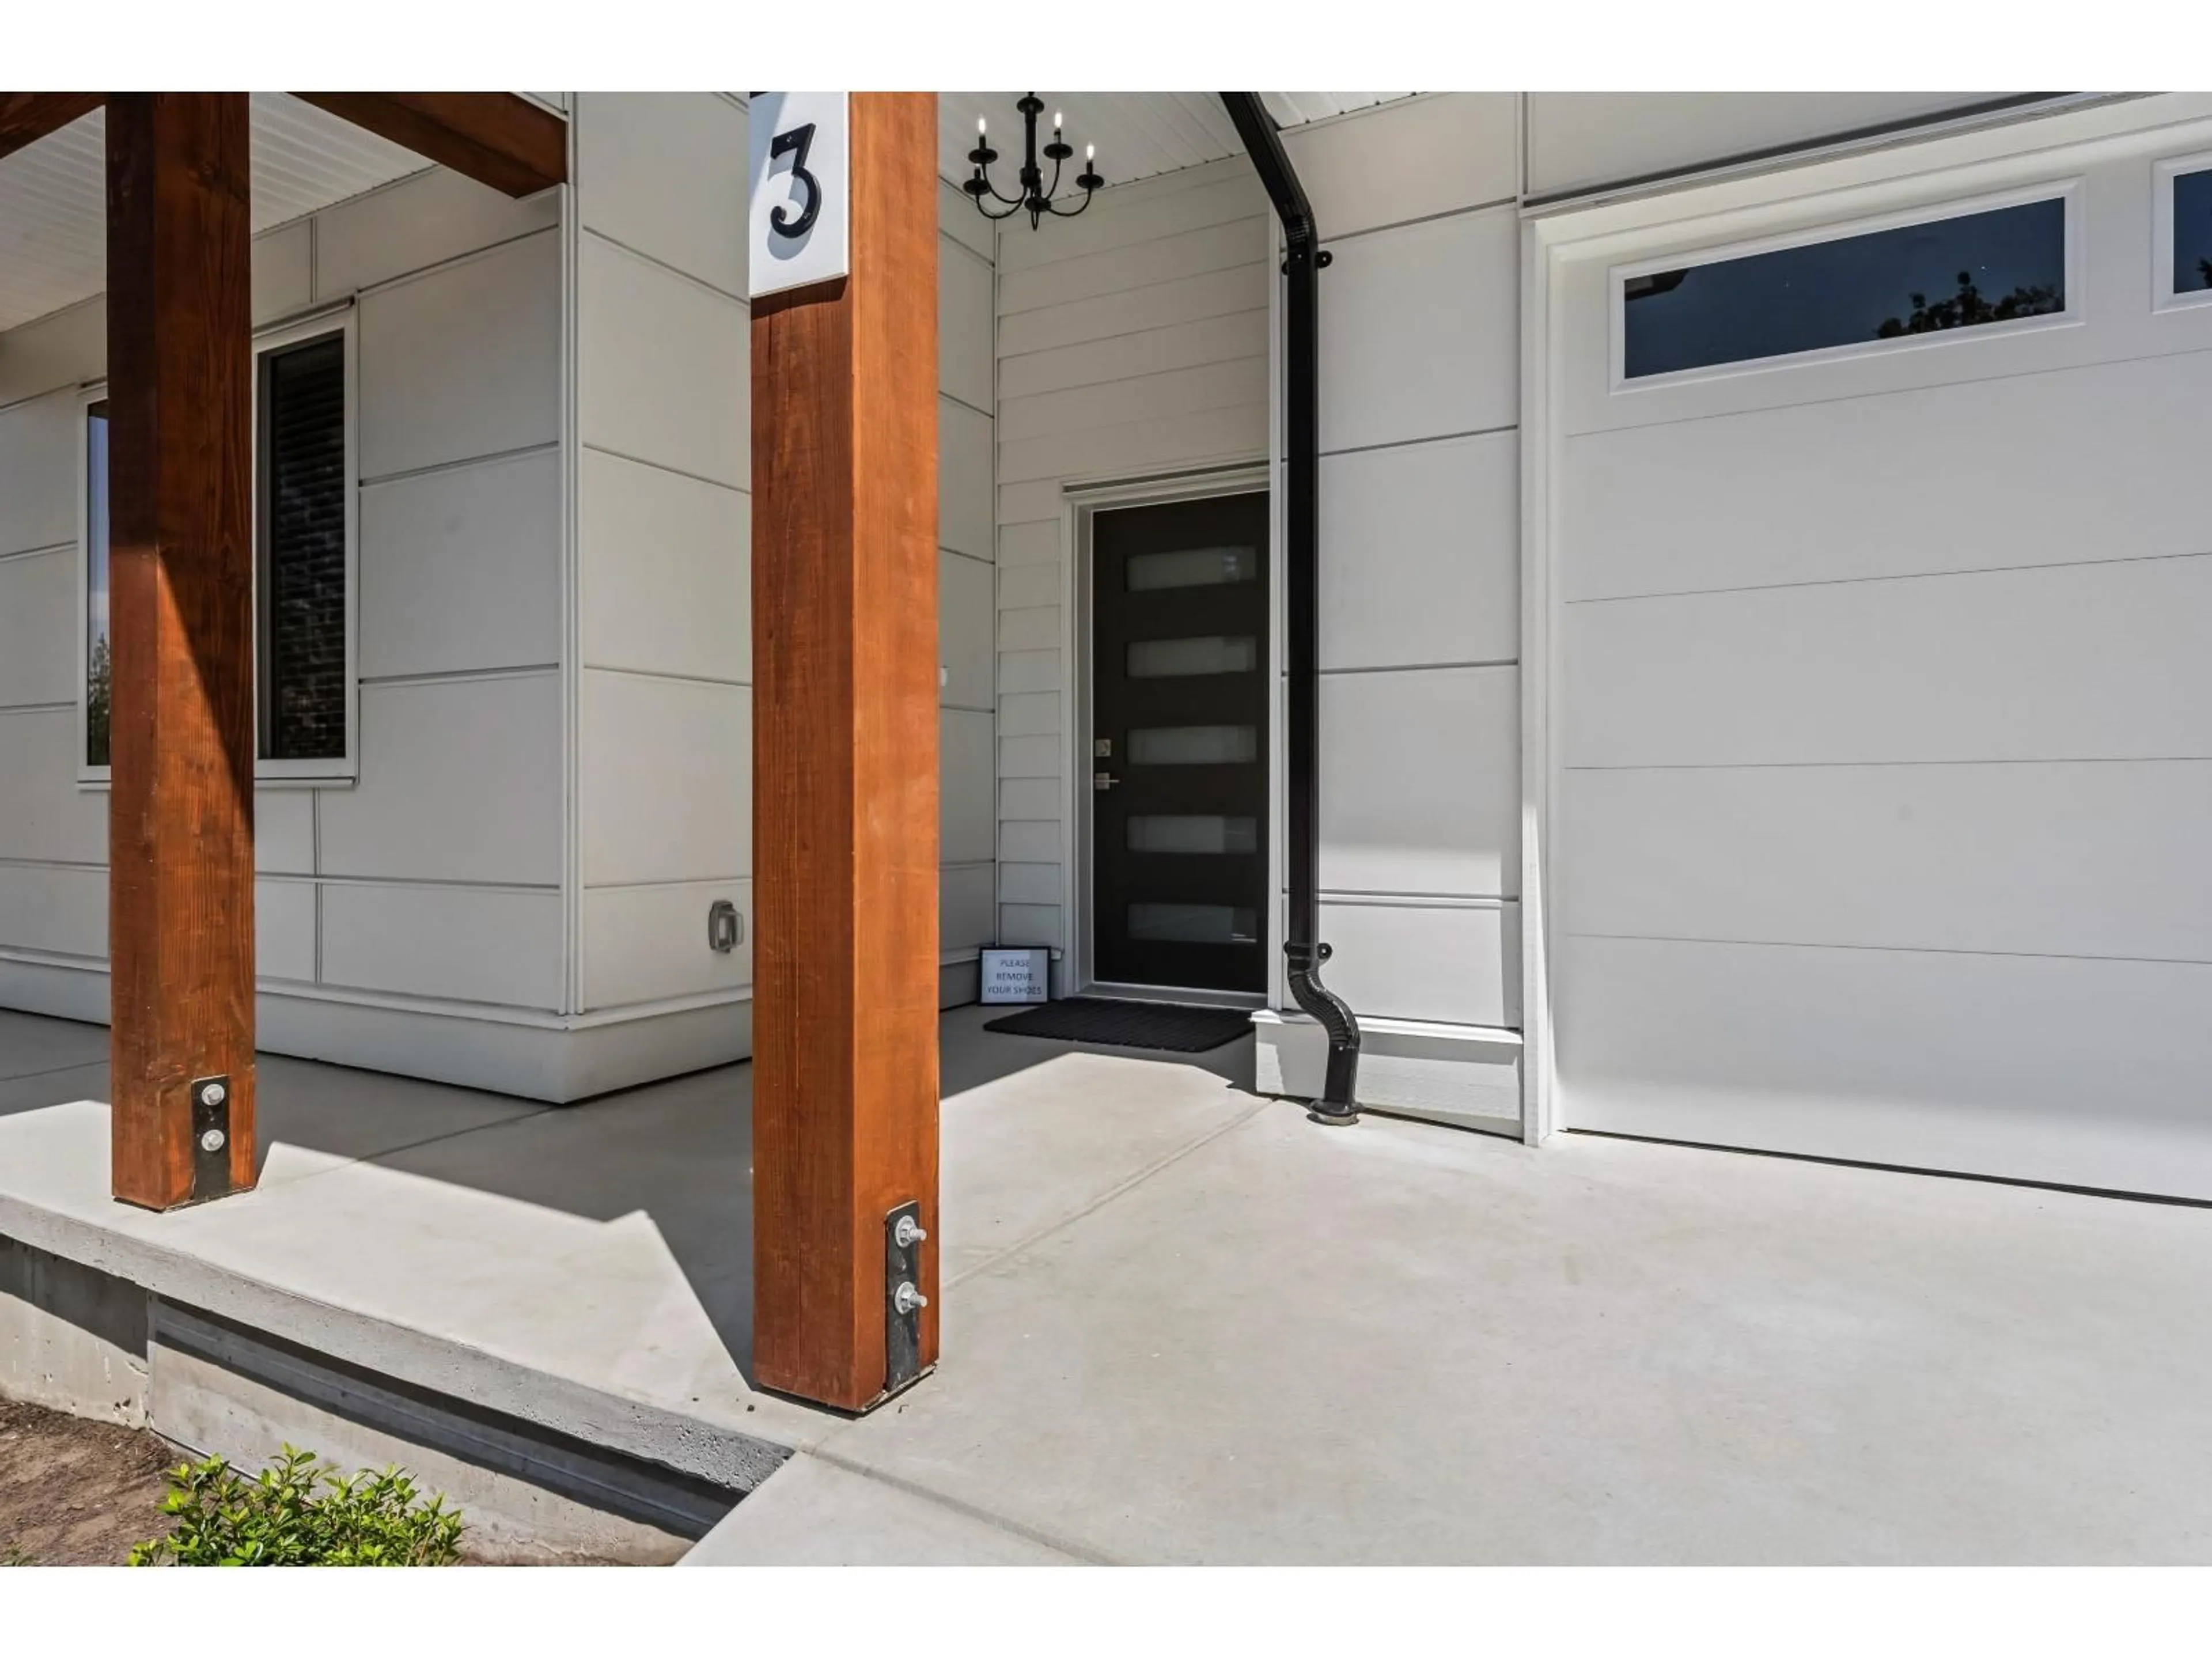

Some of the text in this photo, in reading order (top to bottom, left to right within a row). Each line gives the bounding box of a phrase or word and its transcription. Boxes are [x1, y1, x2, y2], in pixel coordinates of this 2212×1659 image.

[770, 123, 822, 238] 3
[1000, 959, 1029, 967] PLEASE
[997, 973, 1034, 981] REMOVE
[987, 986, 1042, 995] YOUR SHOES
